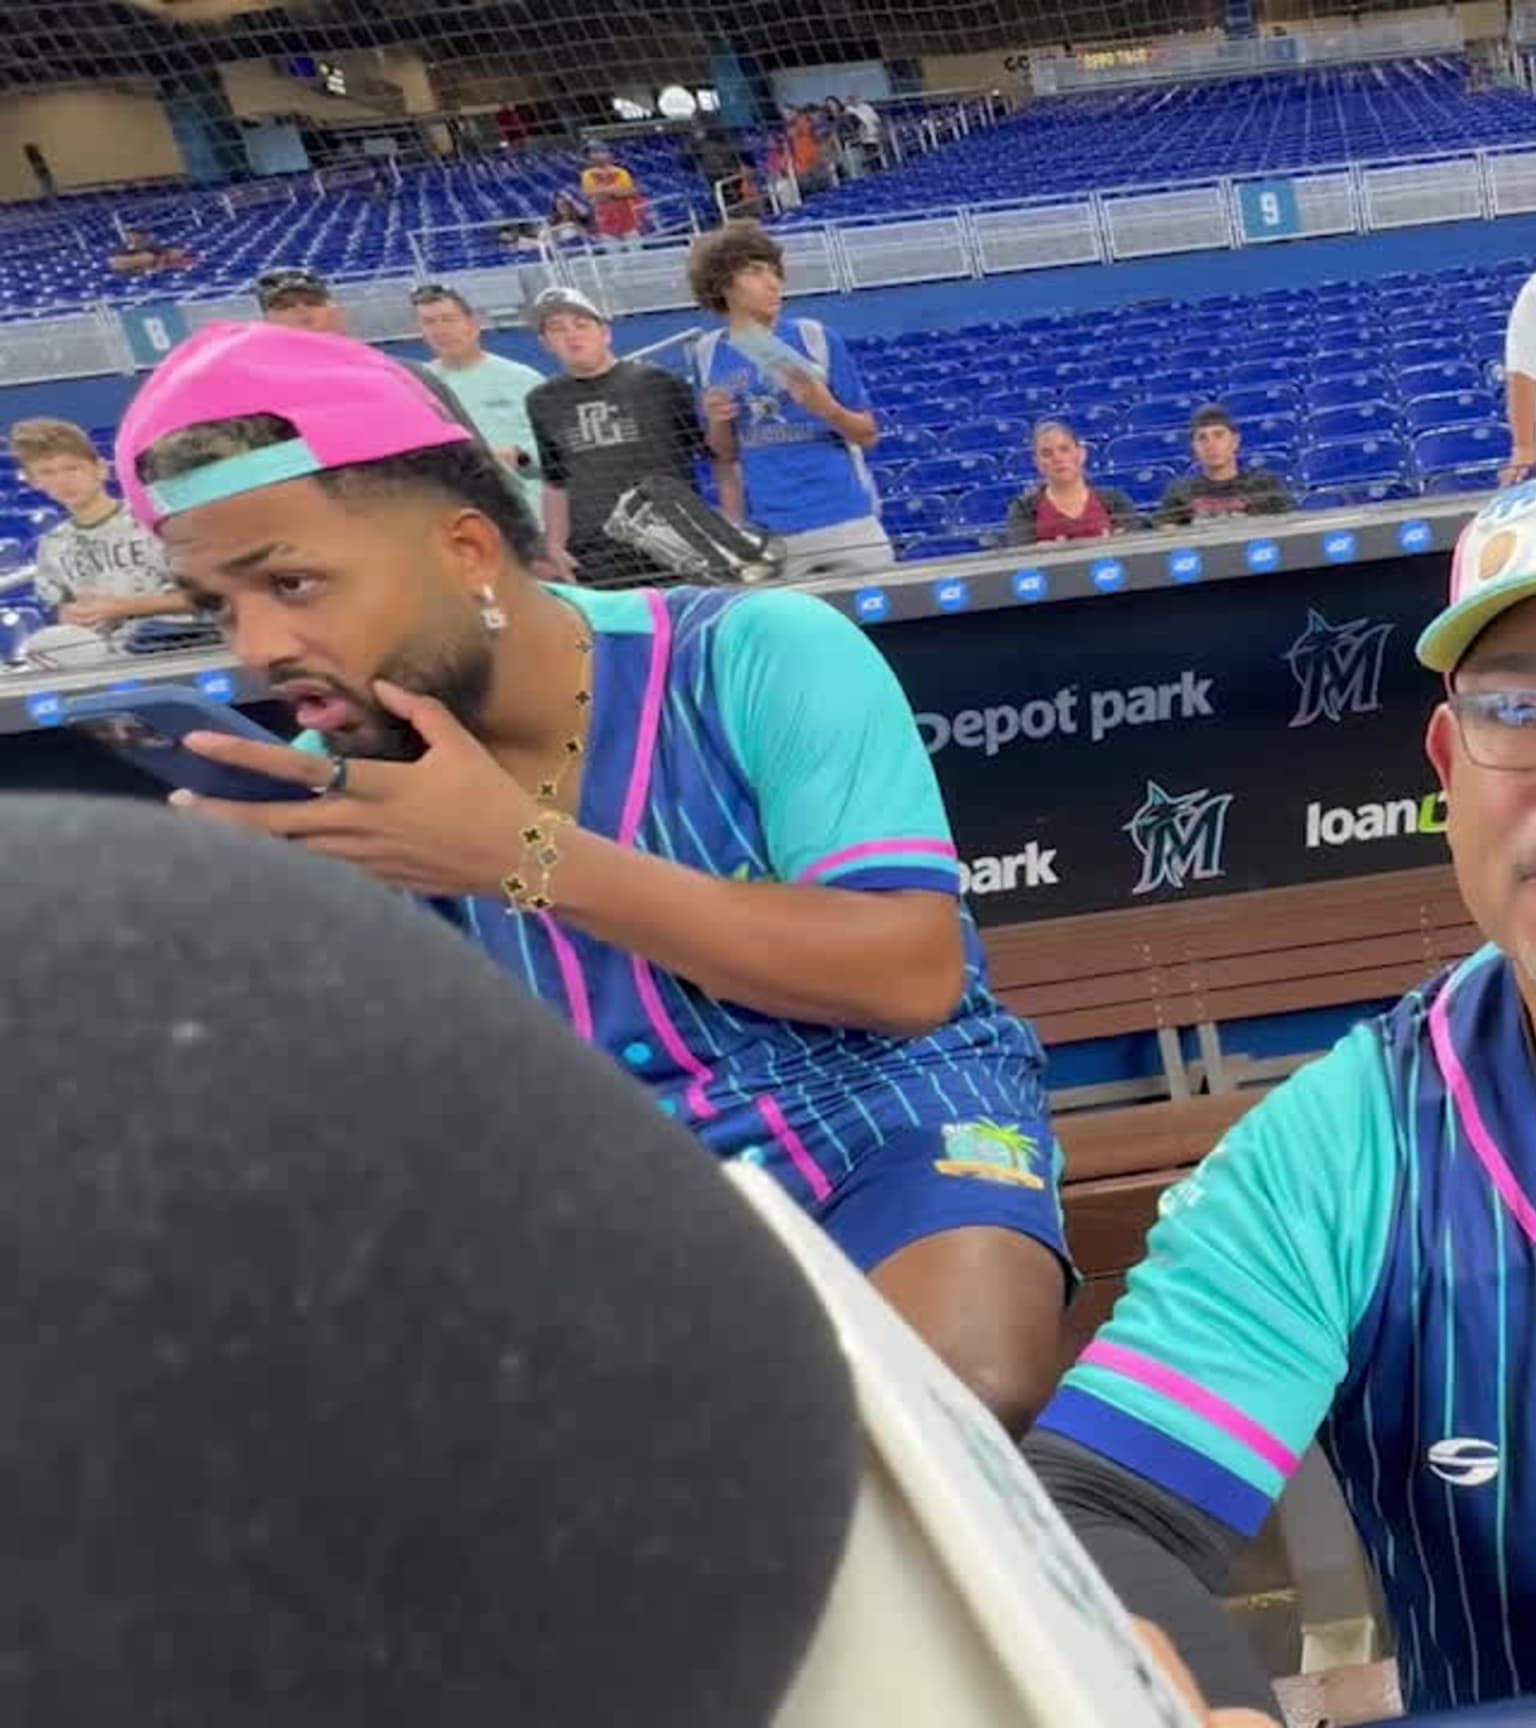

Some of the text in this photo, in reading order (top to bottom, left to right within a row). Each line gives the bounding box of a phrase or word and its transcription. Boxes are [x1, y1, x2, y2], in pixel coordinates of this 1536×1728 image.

[1260, 191, 1279, 225] 9
[143, 317, 171, 351] 8
[1091, 671, 1216, 741] park
